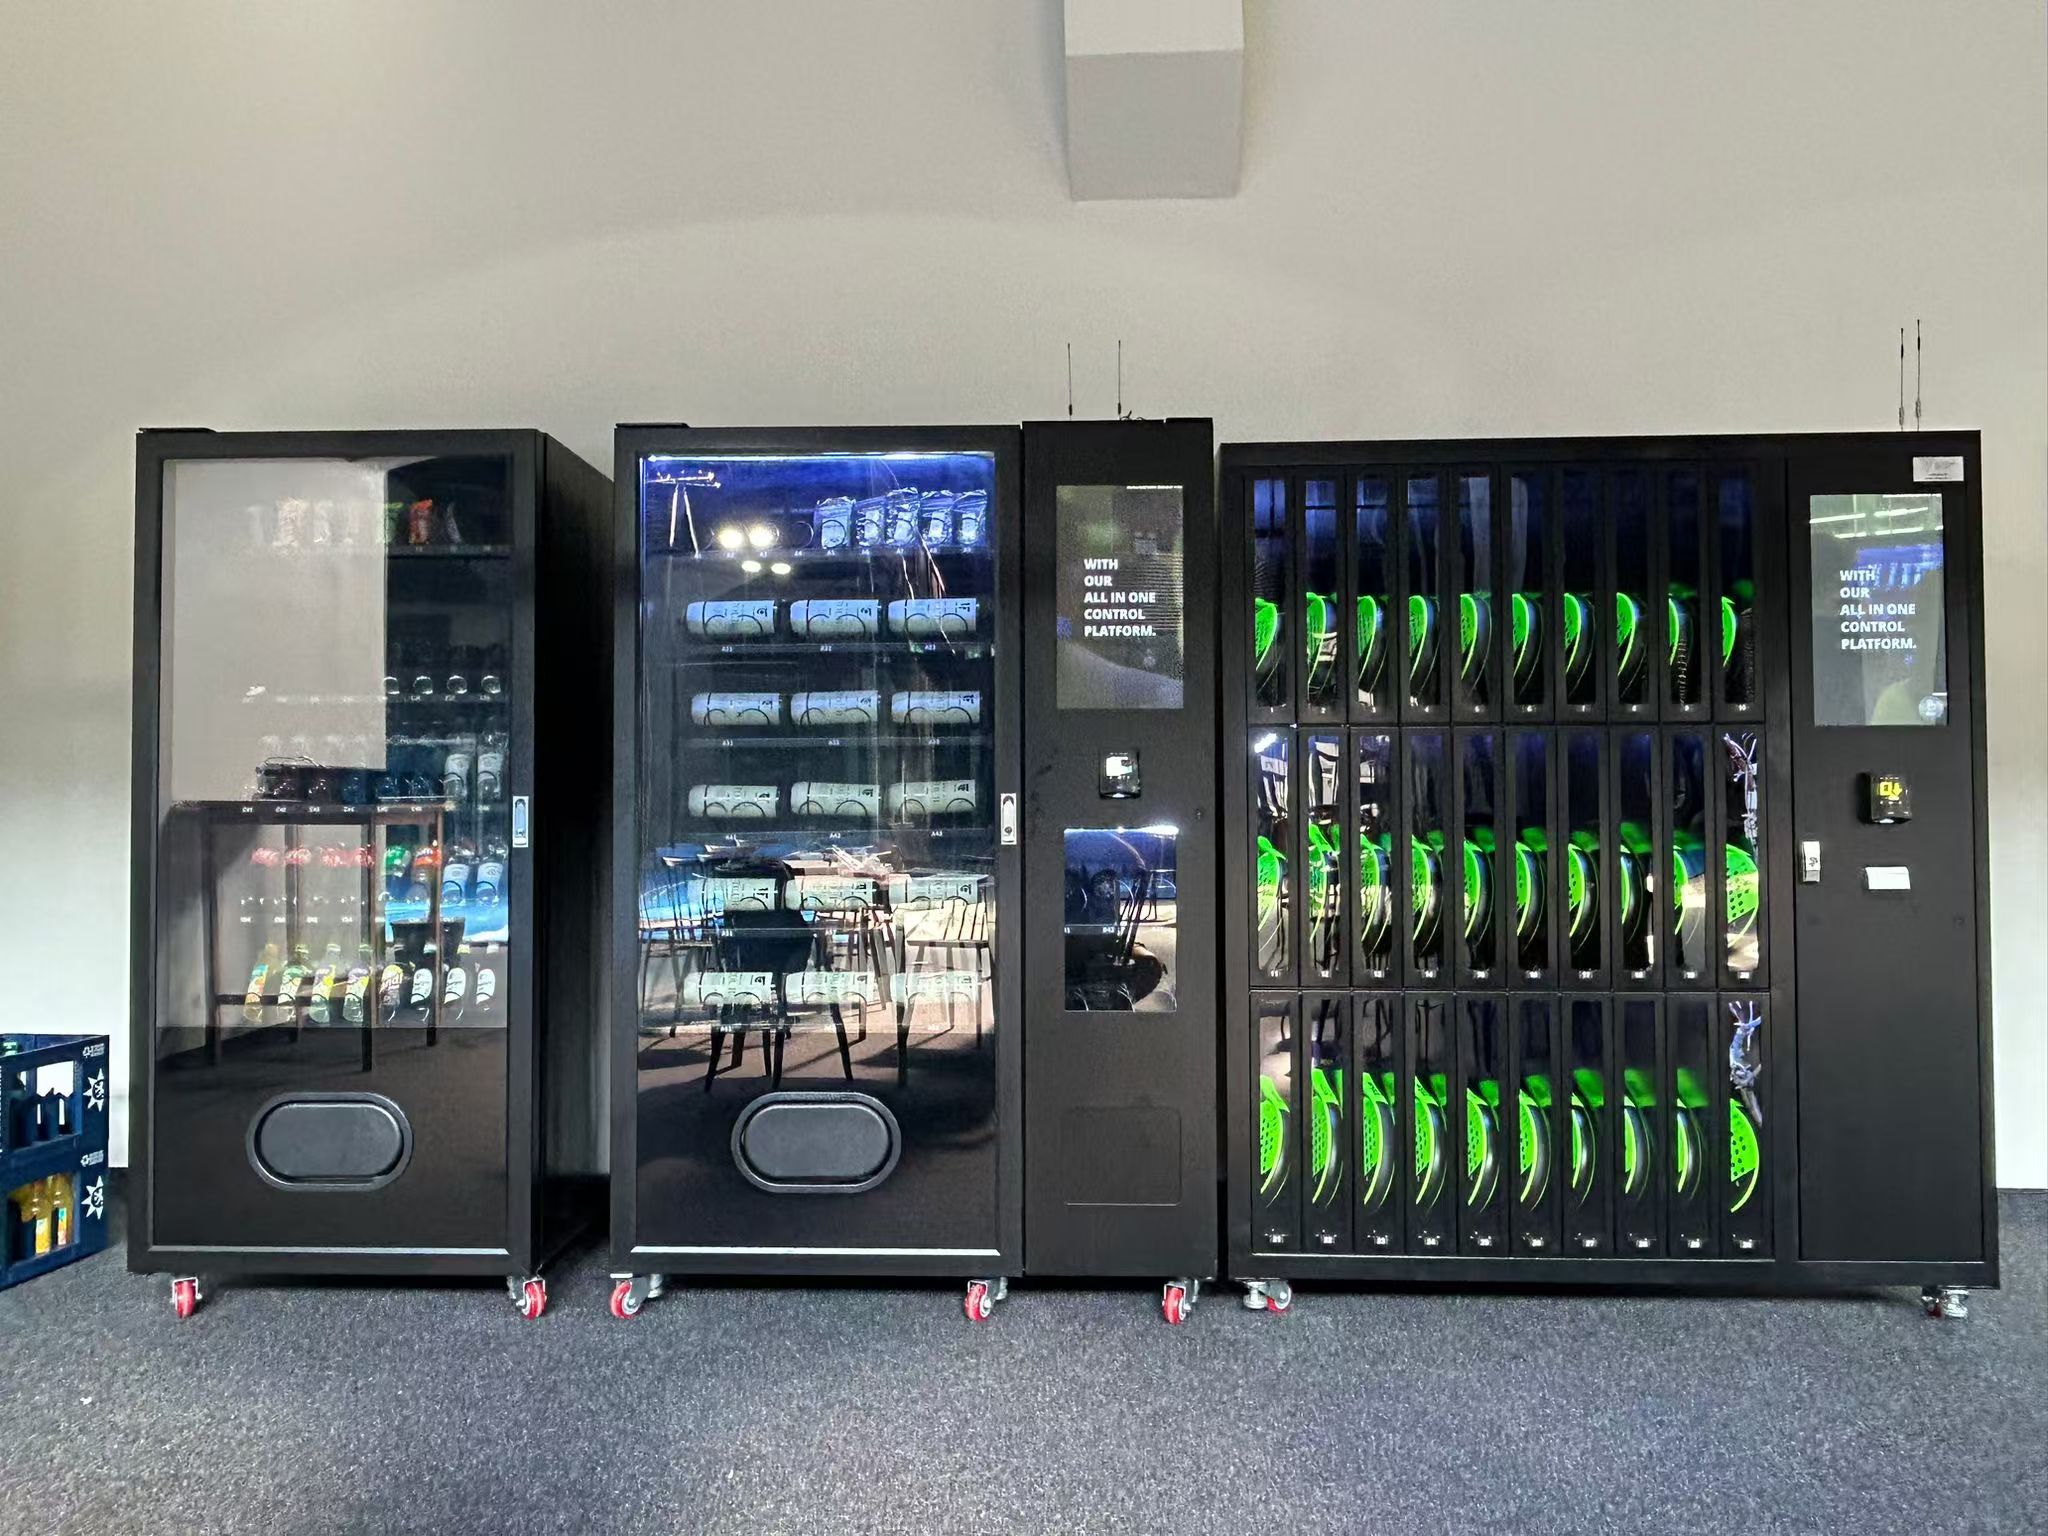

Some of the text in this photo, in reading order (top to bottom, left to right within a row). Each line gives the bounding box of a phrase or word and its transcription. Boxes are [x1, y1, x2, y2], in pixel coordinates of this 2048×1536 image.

[1084, 558, 1118, 570] WITH
[1084, 575, 1113, 587] OUR
[1840, 570, 1875, 581] WITH
[1084, 592, 1156, 603] ALL IN ONE
[1840, 587, 1870, 598] OUR
[1084, 608, 1146, 620] CONTROL
[1840, 603, 1916, 615] ALL IN ONE
[1084, 625, 1156, 637] PLATFORM.
[1841, 621, 1905, 633] CONTROL
[1841, 638, 1917, 650] PLATFORM.
